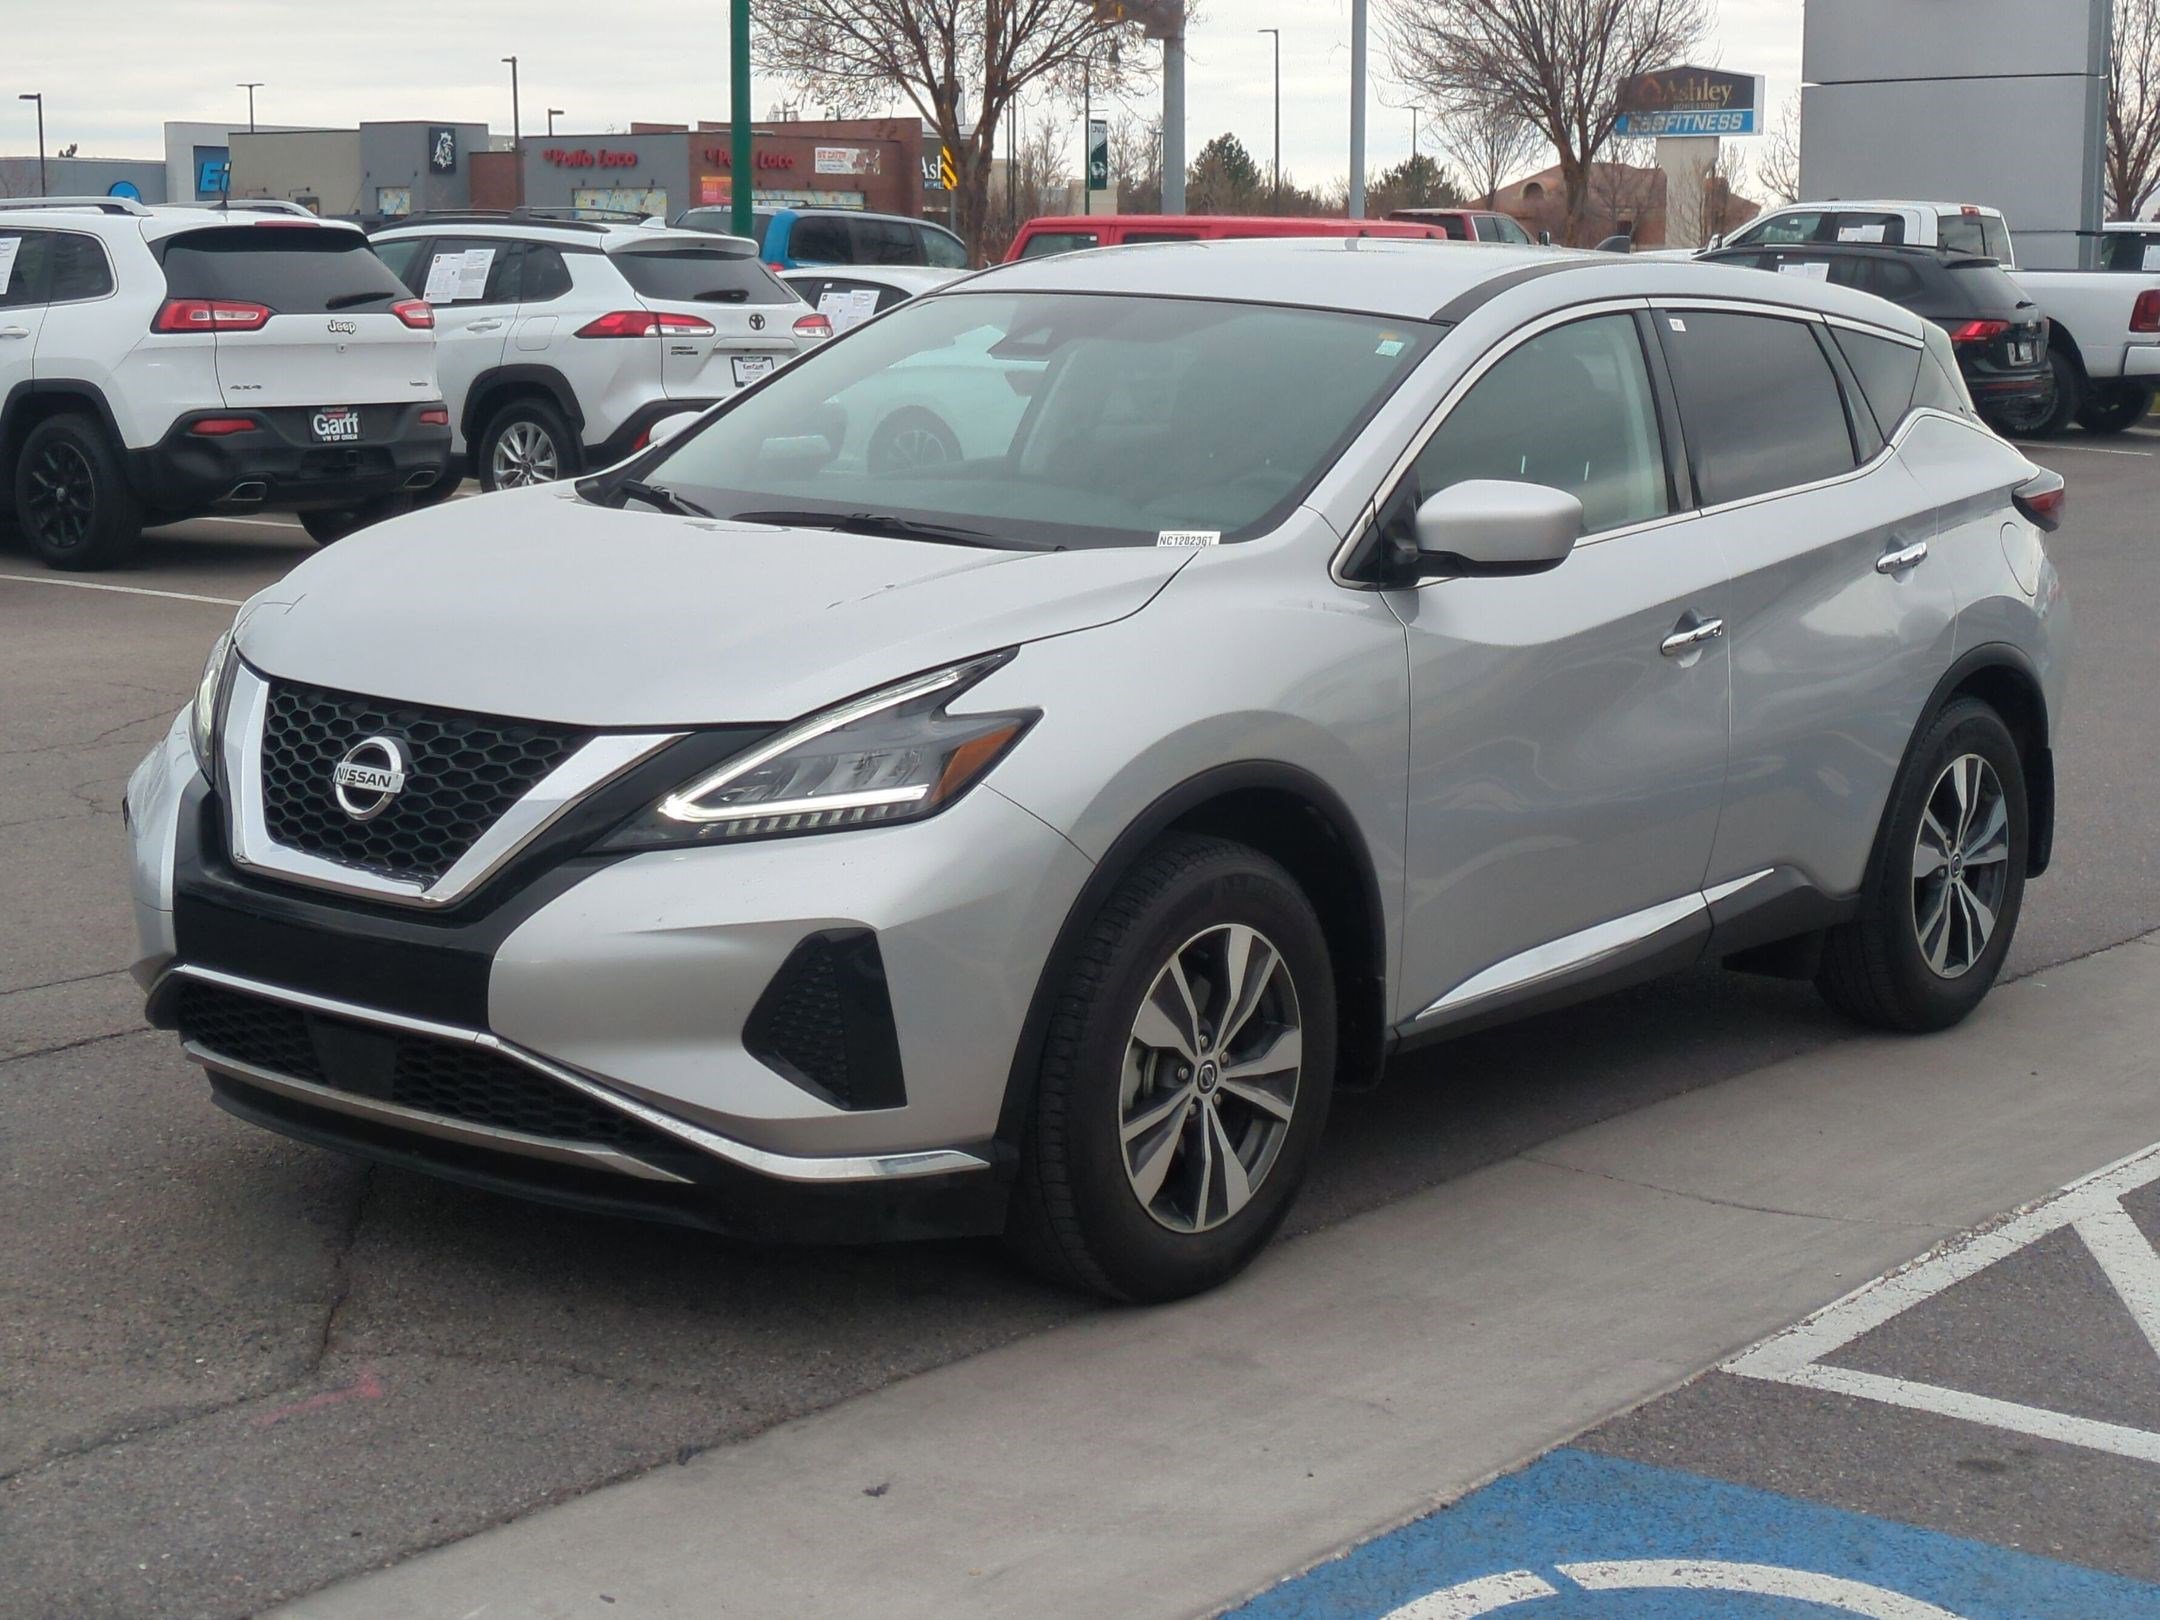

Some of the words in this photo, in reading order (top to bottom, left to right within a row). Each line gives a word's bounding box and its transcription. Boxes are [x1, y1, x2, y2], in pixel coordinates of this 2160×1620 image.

[1664, 78, 1732, 106] Ashley
[597, 149, 638, 168] Loco
[757, 150, 796, 169] Loco
[328, 320, 356, 334] Jeep
[313, 412, 358, 436] Garff
[336, 767, 392, 788] NISSAN
